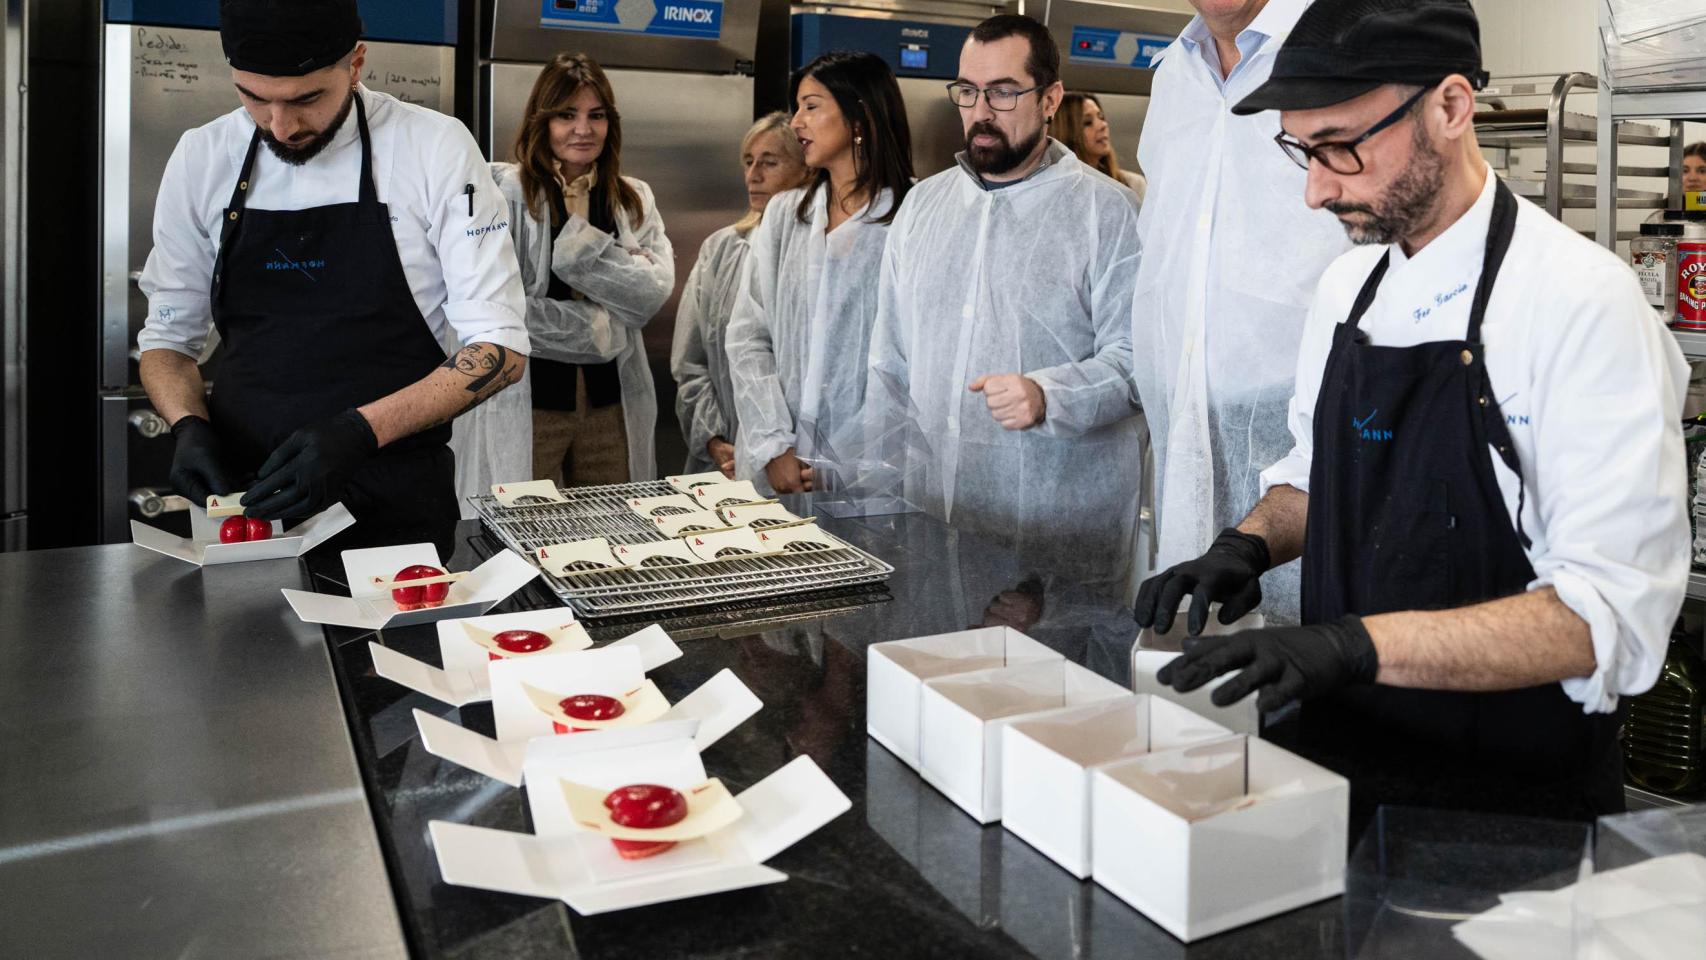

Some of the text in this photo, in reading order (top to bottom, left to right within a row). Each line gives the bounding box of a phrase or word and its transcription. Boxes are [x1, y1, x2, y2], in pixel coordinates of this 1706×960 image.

[664, 6, 713, 23] IRINOX
[467, 221, 508, 237] HOFMANN
[211, 498, 220, 507] A
[540, 548, 549, 559] A
